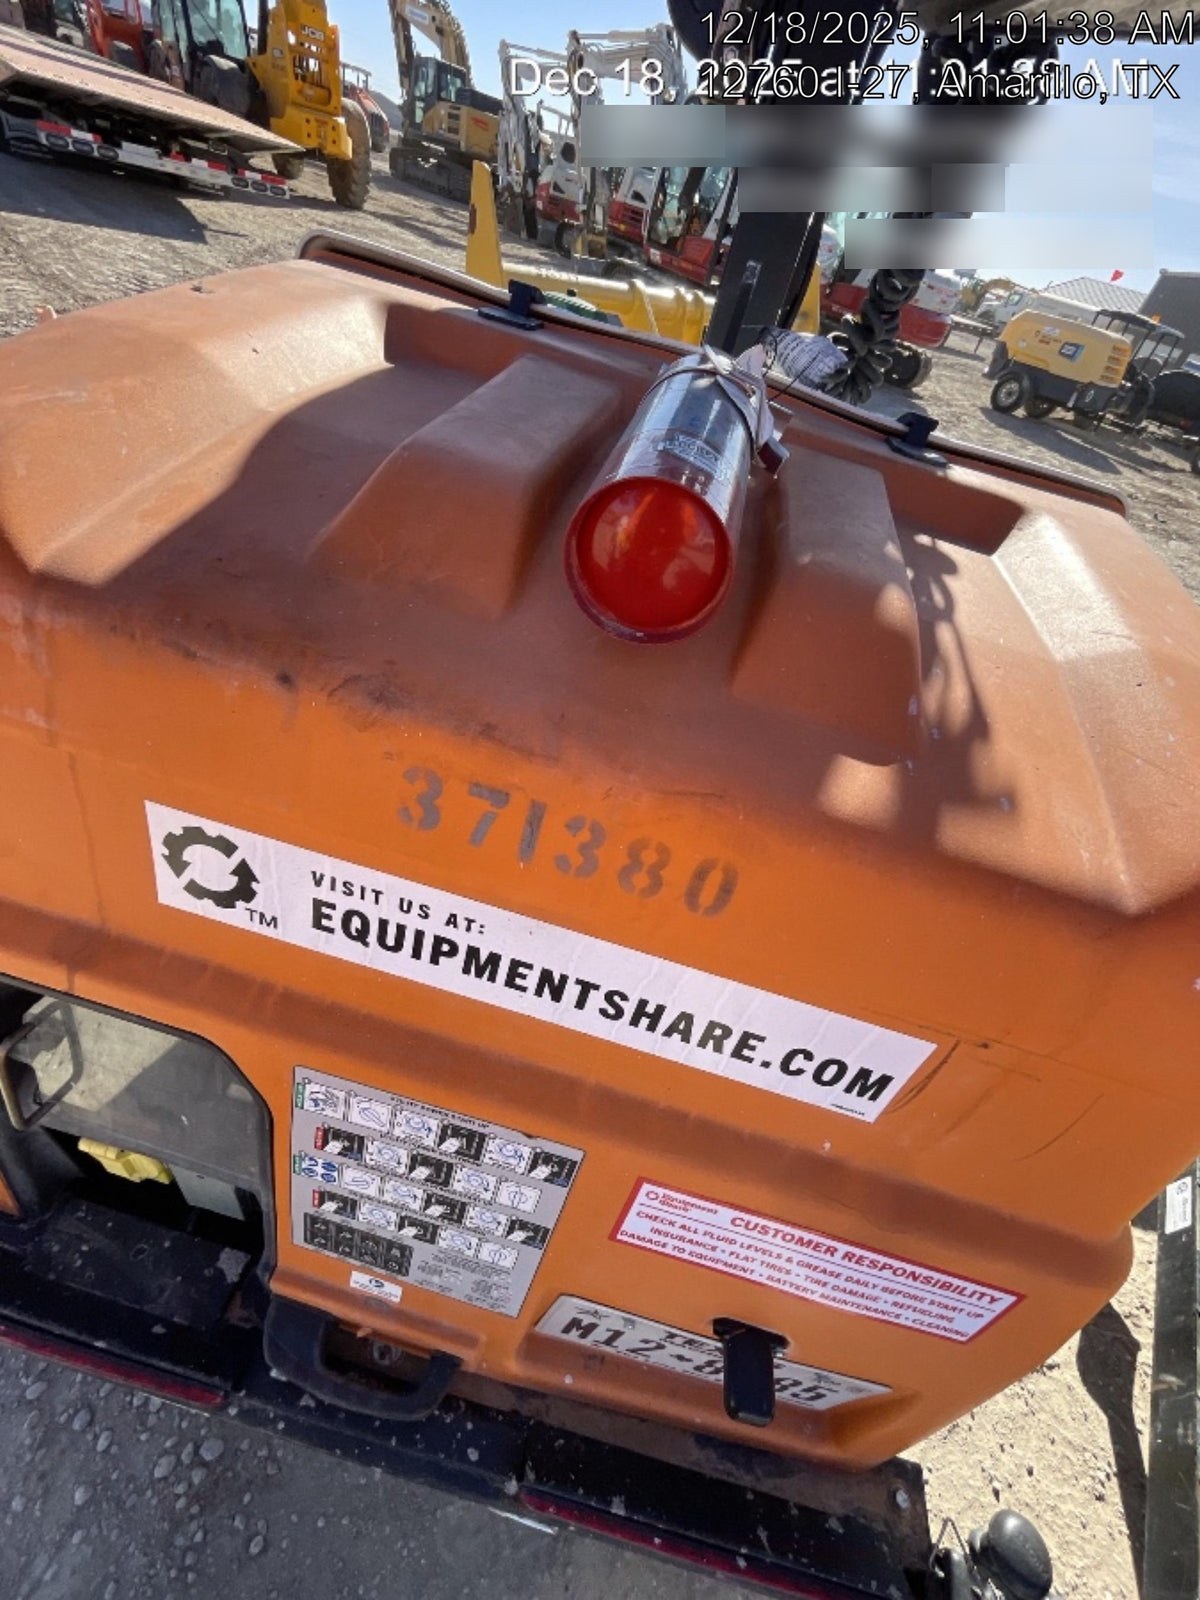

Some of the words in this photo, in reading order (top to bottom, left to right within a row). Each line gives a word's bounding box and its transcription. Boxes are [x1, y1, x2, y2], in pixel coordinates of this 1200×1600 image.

[398, 765, 738, 918] 371380
[311, 870, 384, 906] VISIT
[399, 897, 430, 920] US
[445, 912, 486, 935] AT:
[311, 897, 895, 1102] EQUIPMENTSHARE.COM
[619, 1230, 669, 1249] DAMAGE
[671, 1243, 686, 1255] TO
[688, 1250, 756, 1276] EQUIPMENT
[765, 1274, 817, 1297] BATTERY
[819, 1292, 901, 1321] MAINTENANCE
[637, 1210, 676, 1229] CHECK
[679, 1223, 699, 1235] ALL
[702, 1230, 737, 1246] FLUID
[739, 1241, 783, 1261] LEVELS
[796, 1259, 842, 1279] GREASE
[844, 1275, 879, 1290] DAILY
[881, 1285, 928, 1305] BEFORE
[928, 1299, 965, 1316] START
[967, 1311, 985, 1320] UP
[650, 1226, 718, 1252] INSURANCE
[728, 1250, 757, 1265] FLAT
[759, 1259, 797, 1277] TIRES
[803, 1274, 829, 1289] TIRE
[831, 1282, 882, 1304] DAMAGE
[890, 1300, 955, 1324] REFUELING
[730, 1216, 838, 1258] CUSTOMER
[841, 1250, 1003, 1305] RESPONSIBILITY
